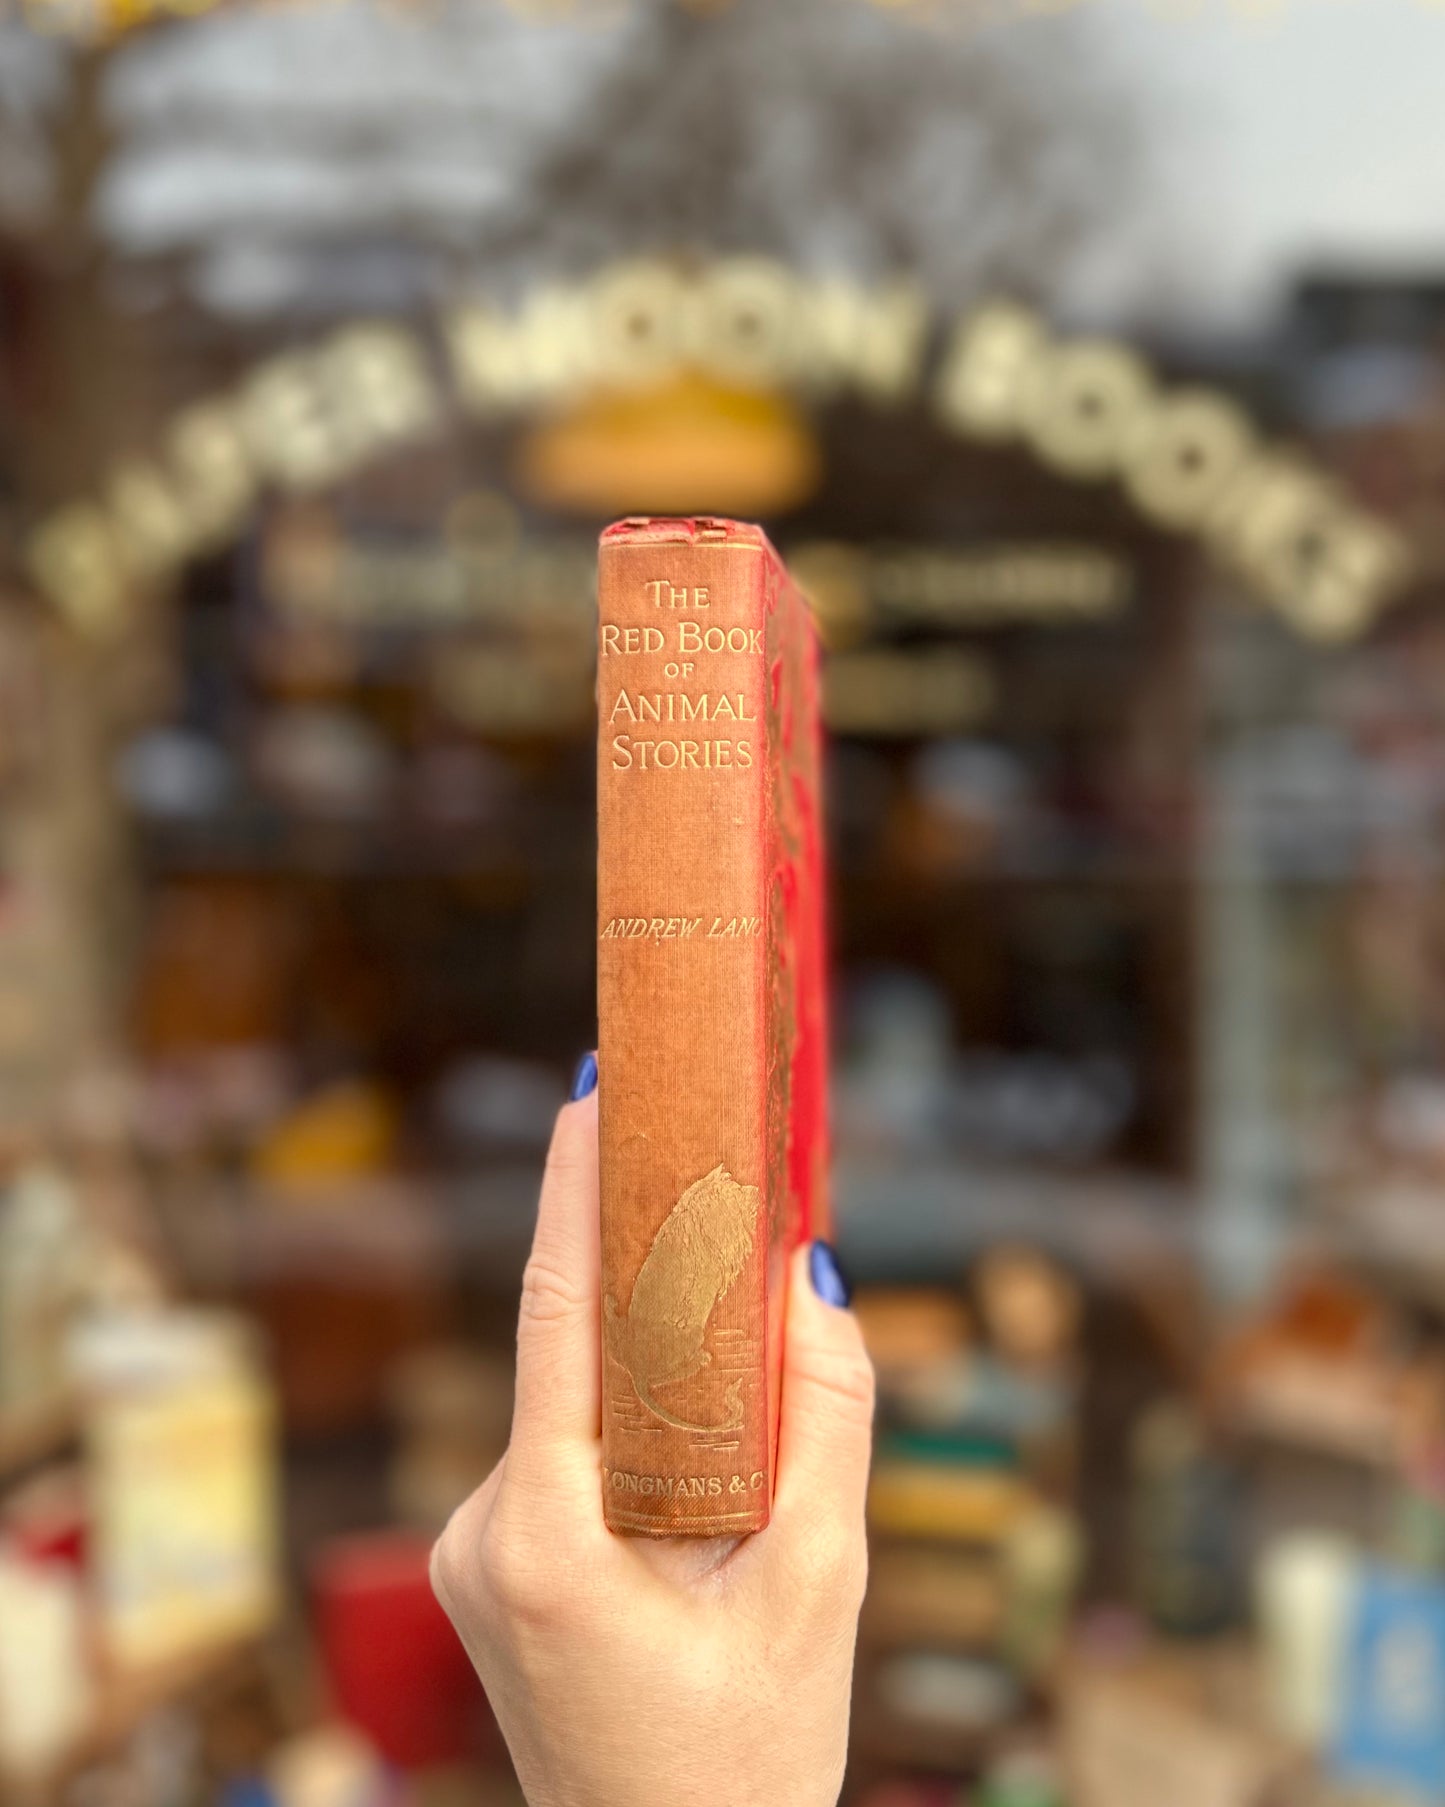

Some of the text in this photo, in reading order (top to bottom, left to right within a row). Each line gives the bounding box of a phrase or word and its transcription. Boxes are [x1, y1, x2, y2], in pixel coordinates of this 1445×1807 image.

[601, 621, 764, 656] RED BOOK
[608, 689, 757, 725] ANIMAL
[612, 735, 753, 770] STORIES
[601, 917, 702, 939] ANDREW
